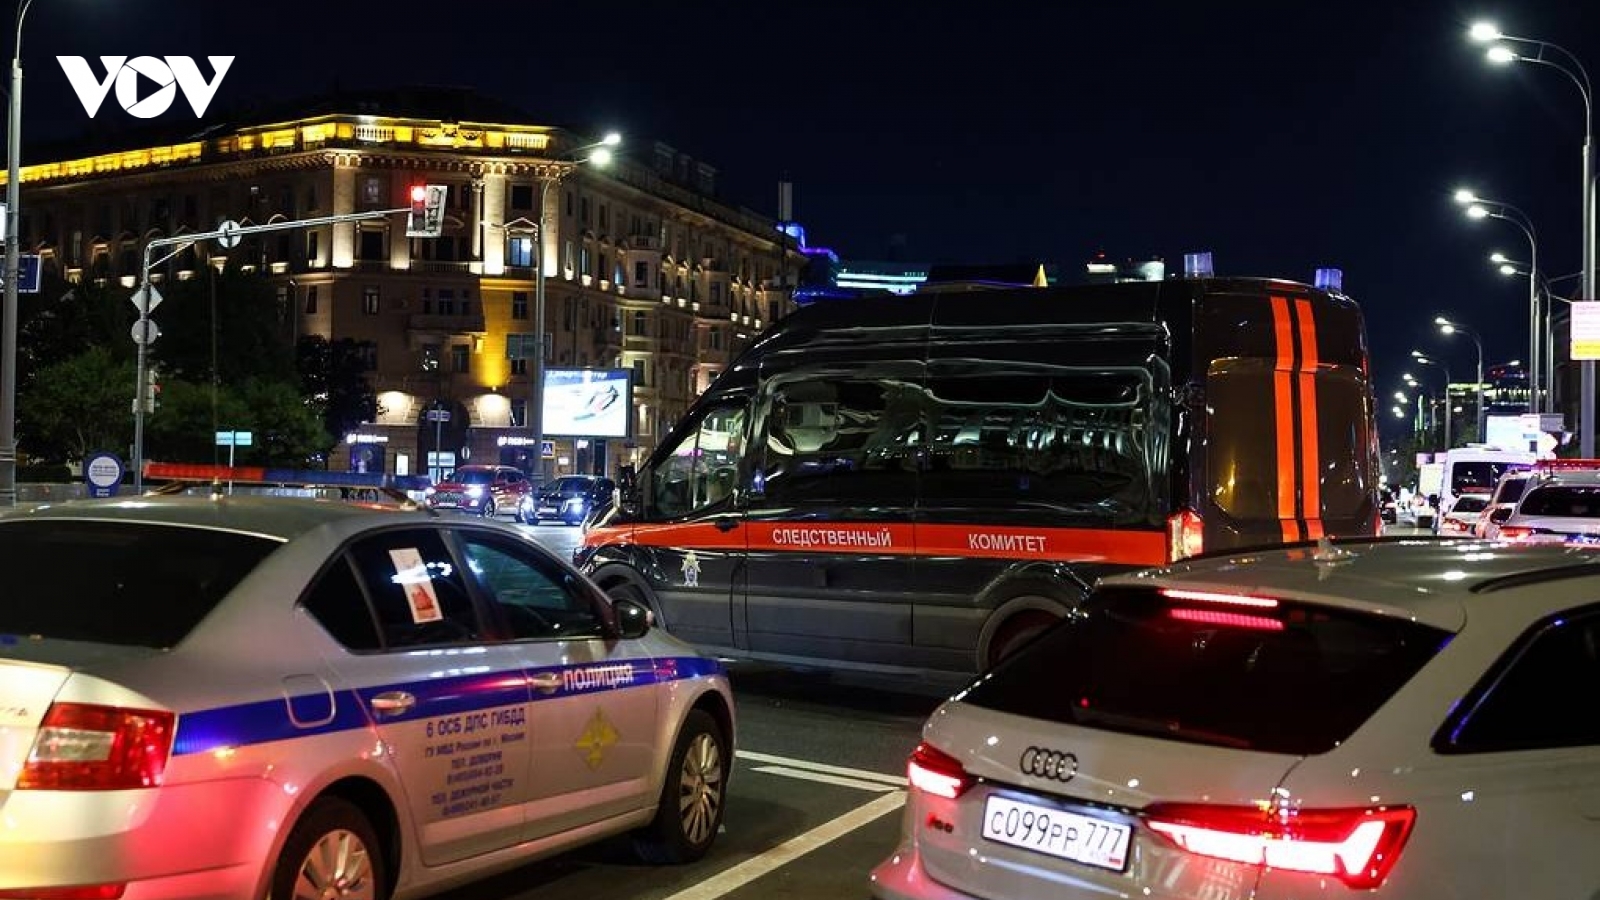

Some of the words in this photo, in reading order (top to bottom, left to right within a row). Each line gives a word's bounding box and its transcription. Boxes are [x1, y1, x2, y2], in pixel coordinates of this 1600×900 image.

[772, 528, 892, 547] СЛЕДСТВЕННЫЙ
[968, 533, 1047, 553] КОМИТЕТ
[563, 663, 634, 691] ПОЛИЦИЯ
[426, 721, 434, 738] 6
[438, 717, 462, 736] ОСБ
[464, 712, 489, 734] ДПС
[490, 707, 525, 728] ГИБДД
